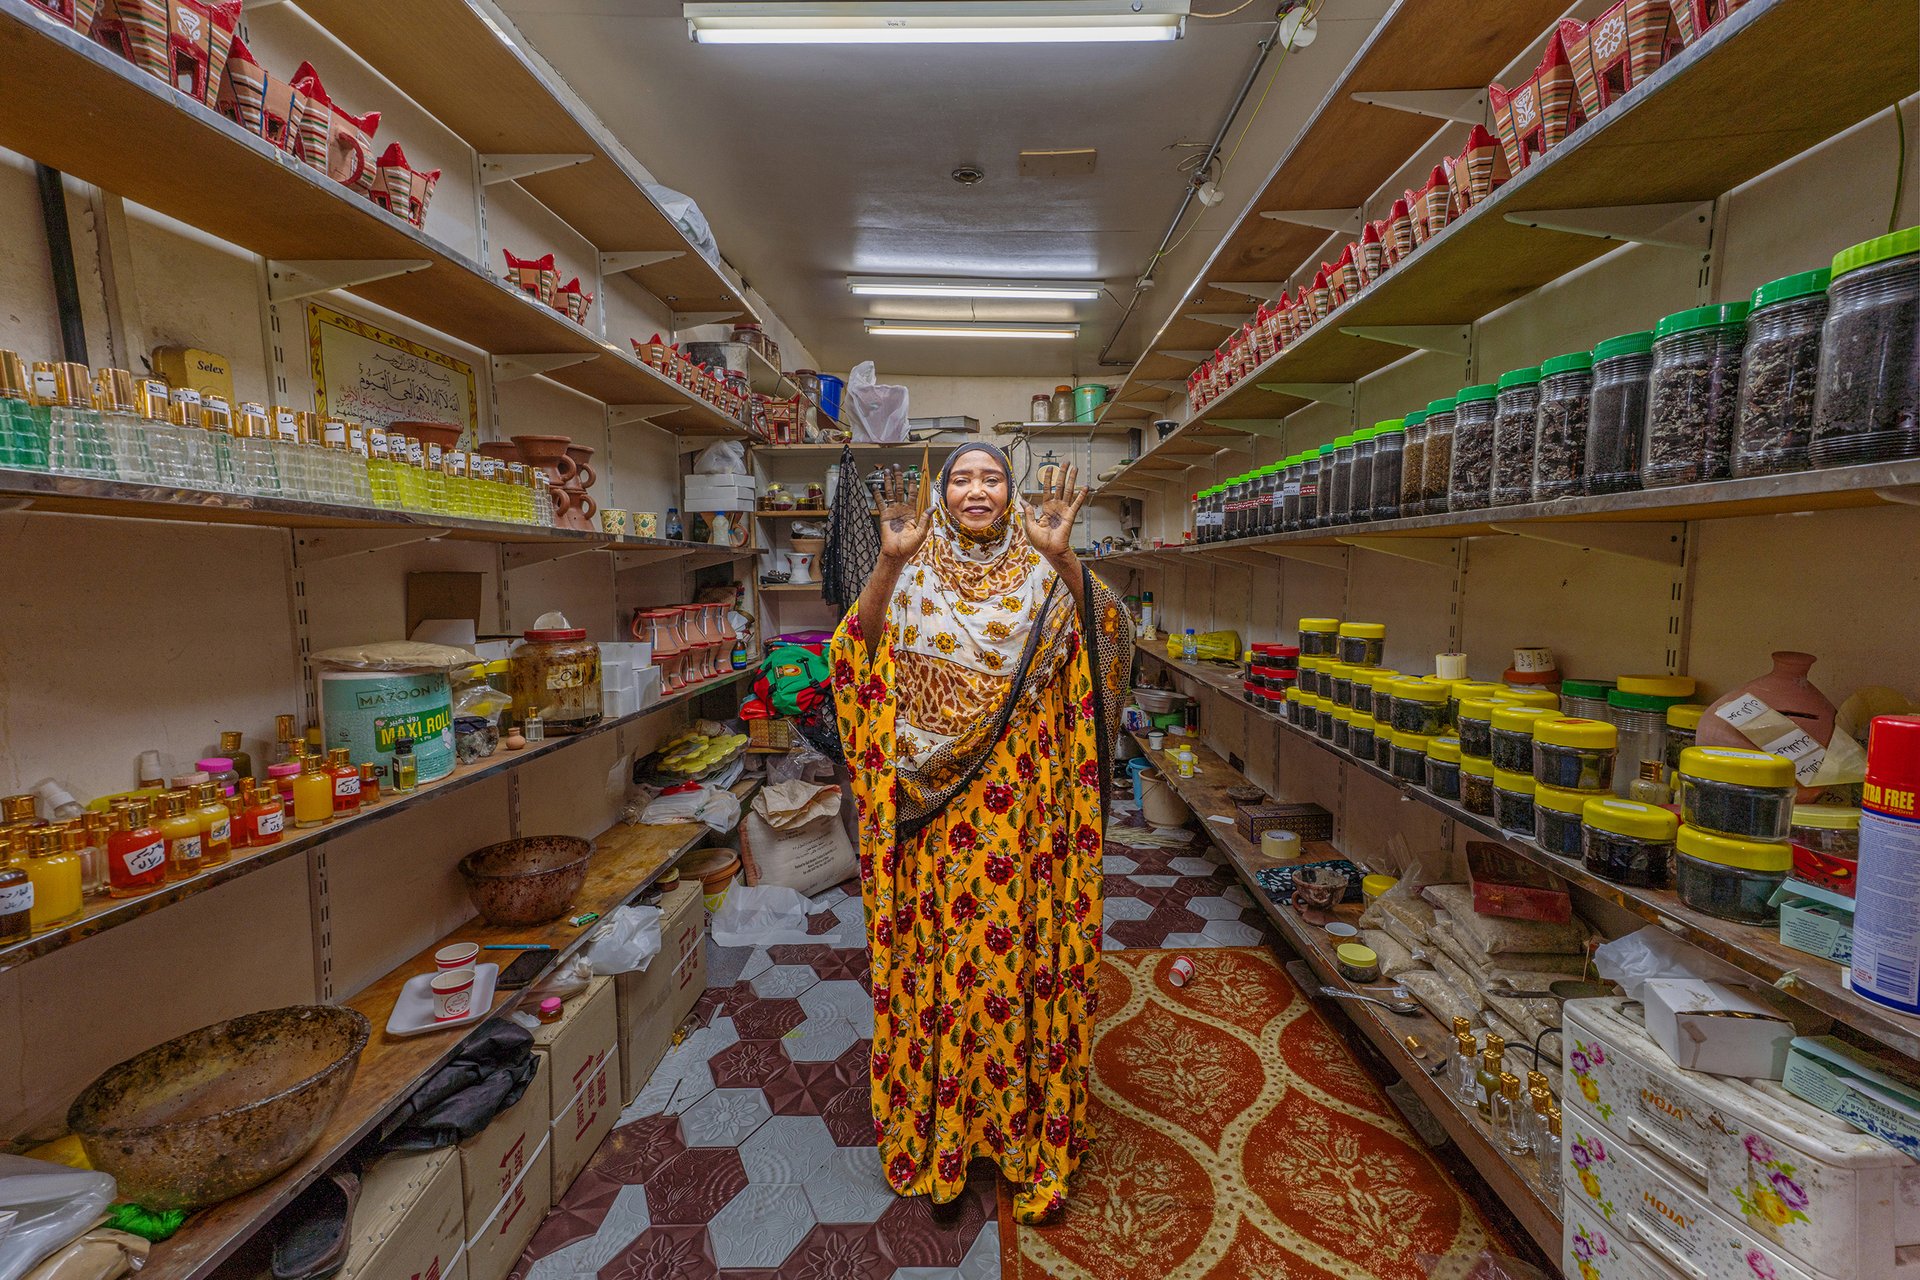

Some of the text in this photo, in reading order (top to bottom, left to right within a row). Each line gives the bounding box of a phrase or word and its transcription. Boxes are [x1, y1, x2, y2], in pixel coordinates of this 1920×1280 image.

[197, 360, 224, 375] Selex
[359, 686, 431, 706] MAZOON
[381, 710, 451, 745] MAXI ROLL
[406, 715, 420, 724] رول
[1884, 788, 1915, 811] FREE
[1641, 1088, 1683, 1121] HOJA
[1643, 1190, 1686, 1229] HOJA
